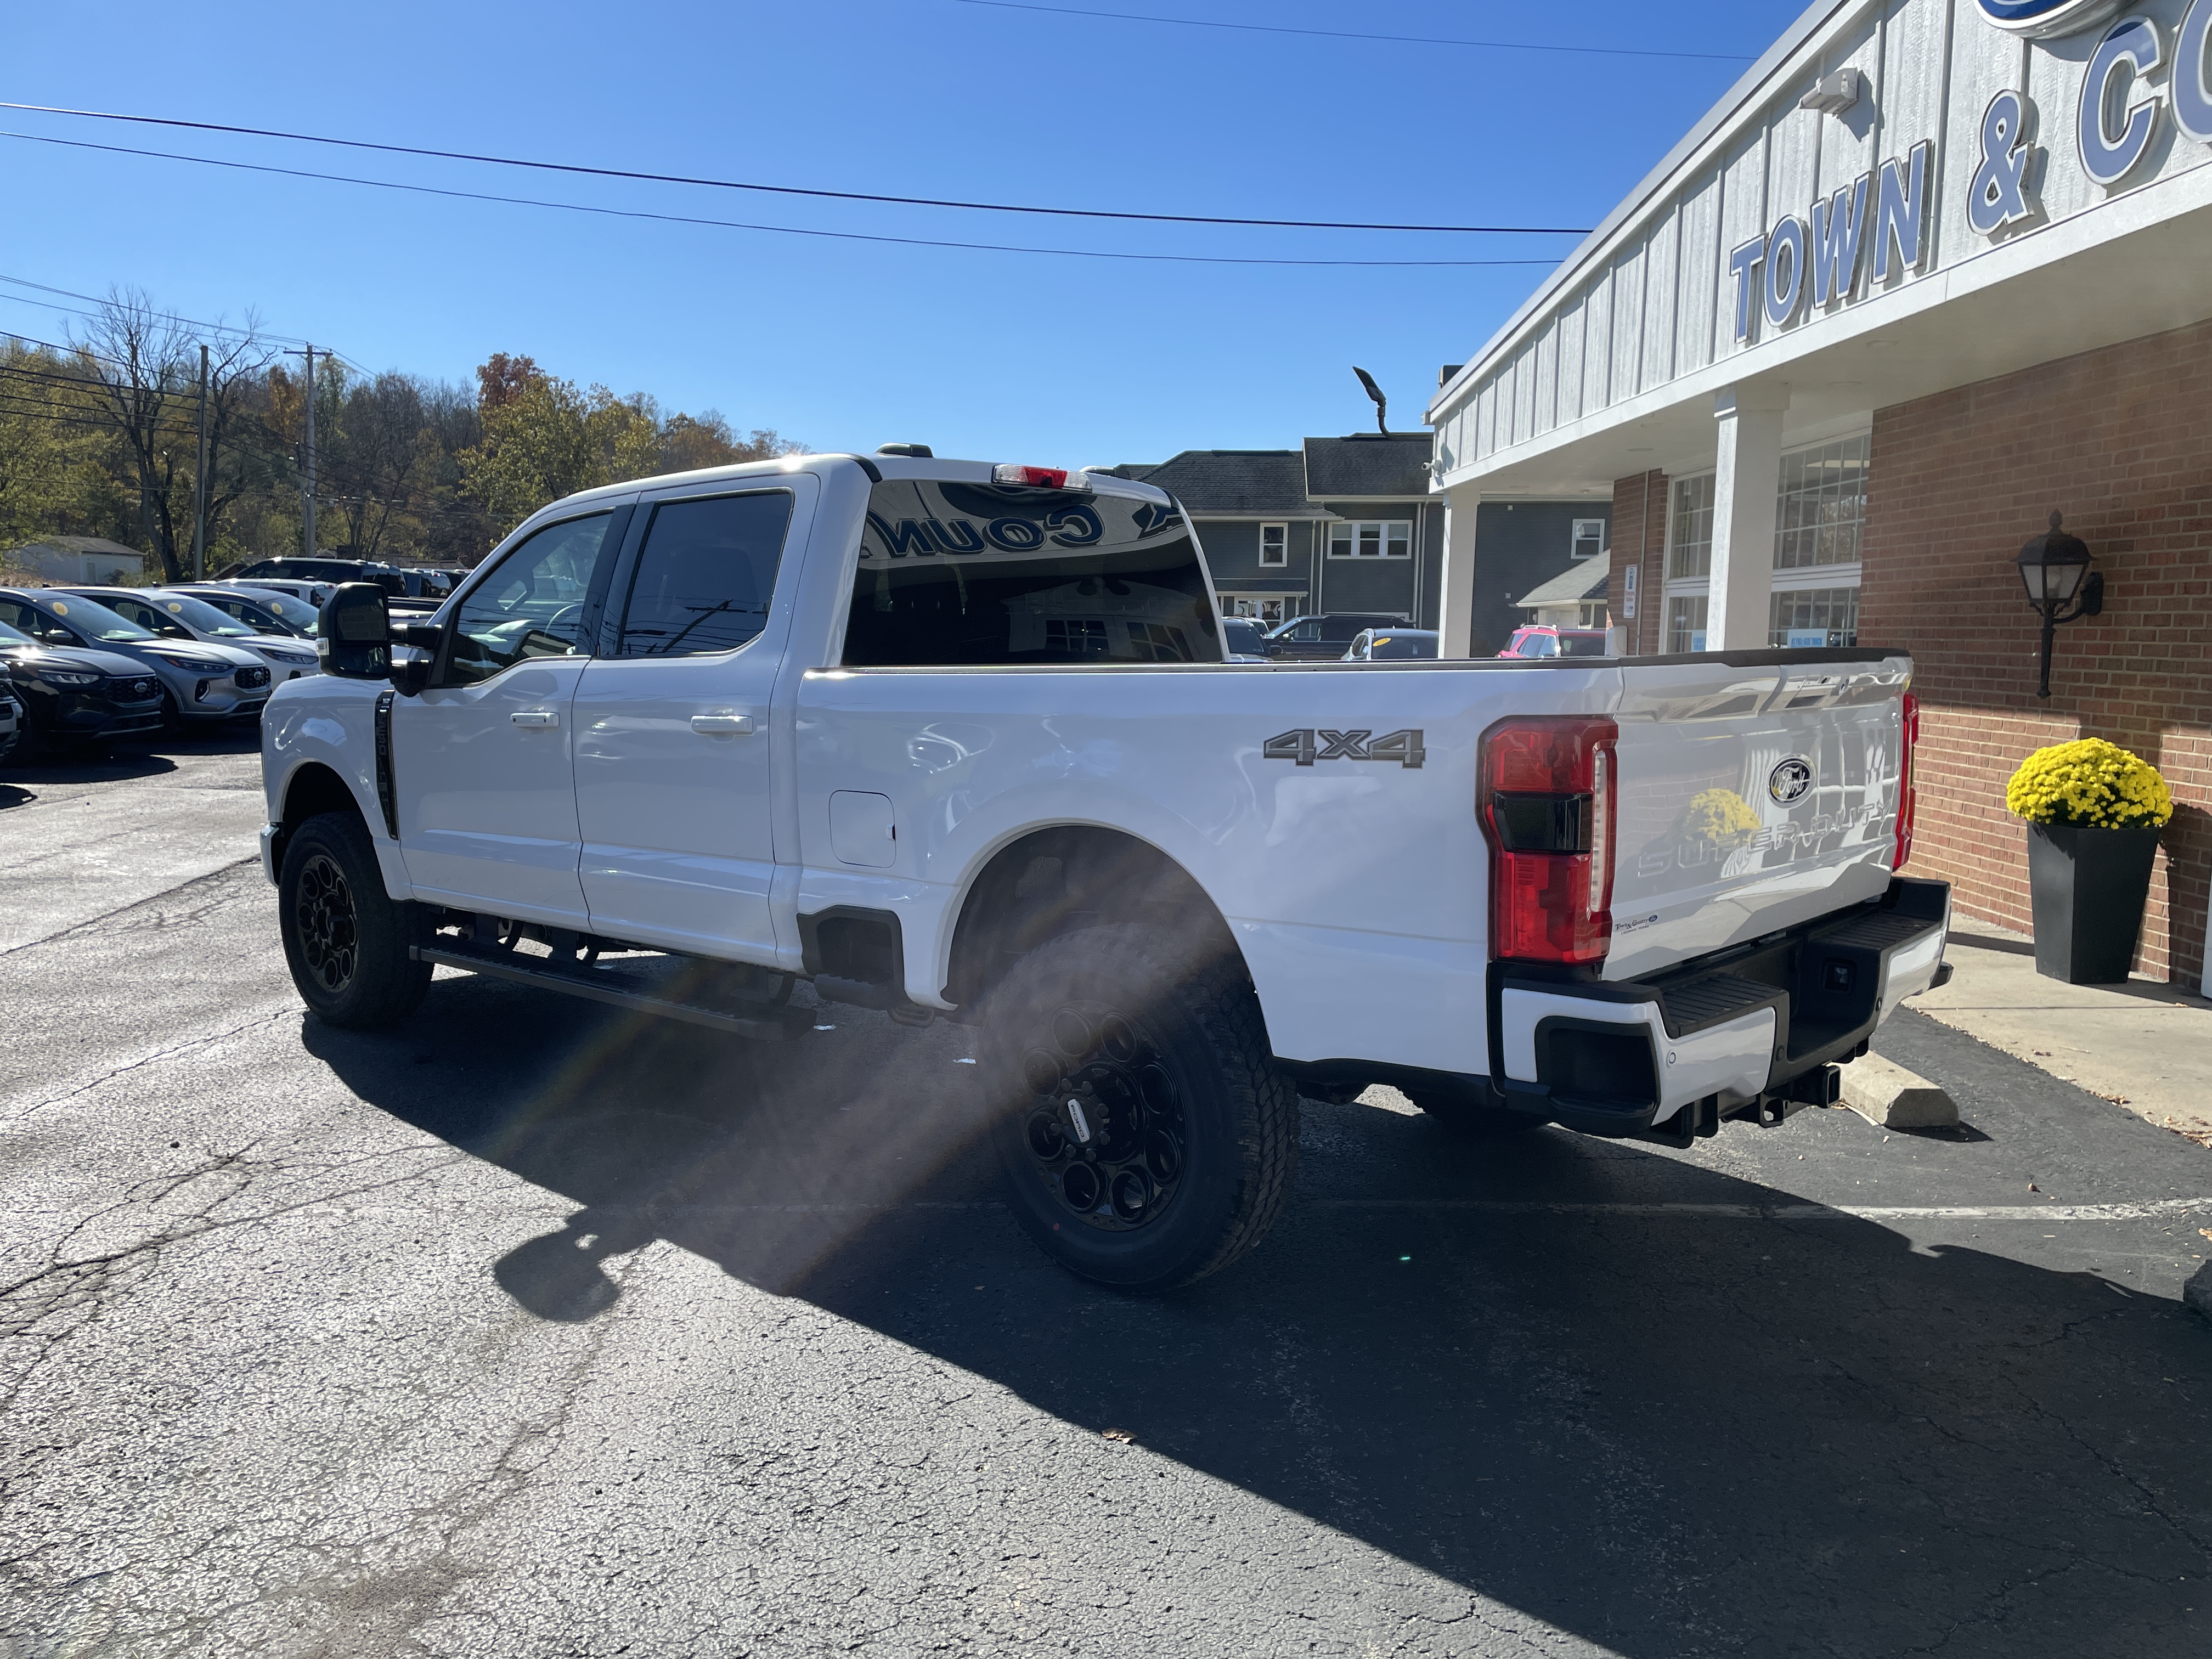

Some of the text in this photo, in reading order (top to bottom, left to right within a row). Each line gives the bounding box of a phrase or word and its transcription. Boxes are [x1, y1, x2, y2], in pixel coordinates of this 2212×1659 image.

[1730, 139, 1933, 344] TOWN
[1967, 89, 2034, 236] &
[1263, 728, 1426, 769] 4X4
[1778, 766, 1810, 795] Ford
[1638, 799, 1893, 878] SUPER DUTY
[1070, 1104, 1085, 1137] FORD
